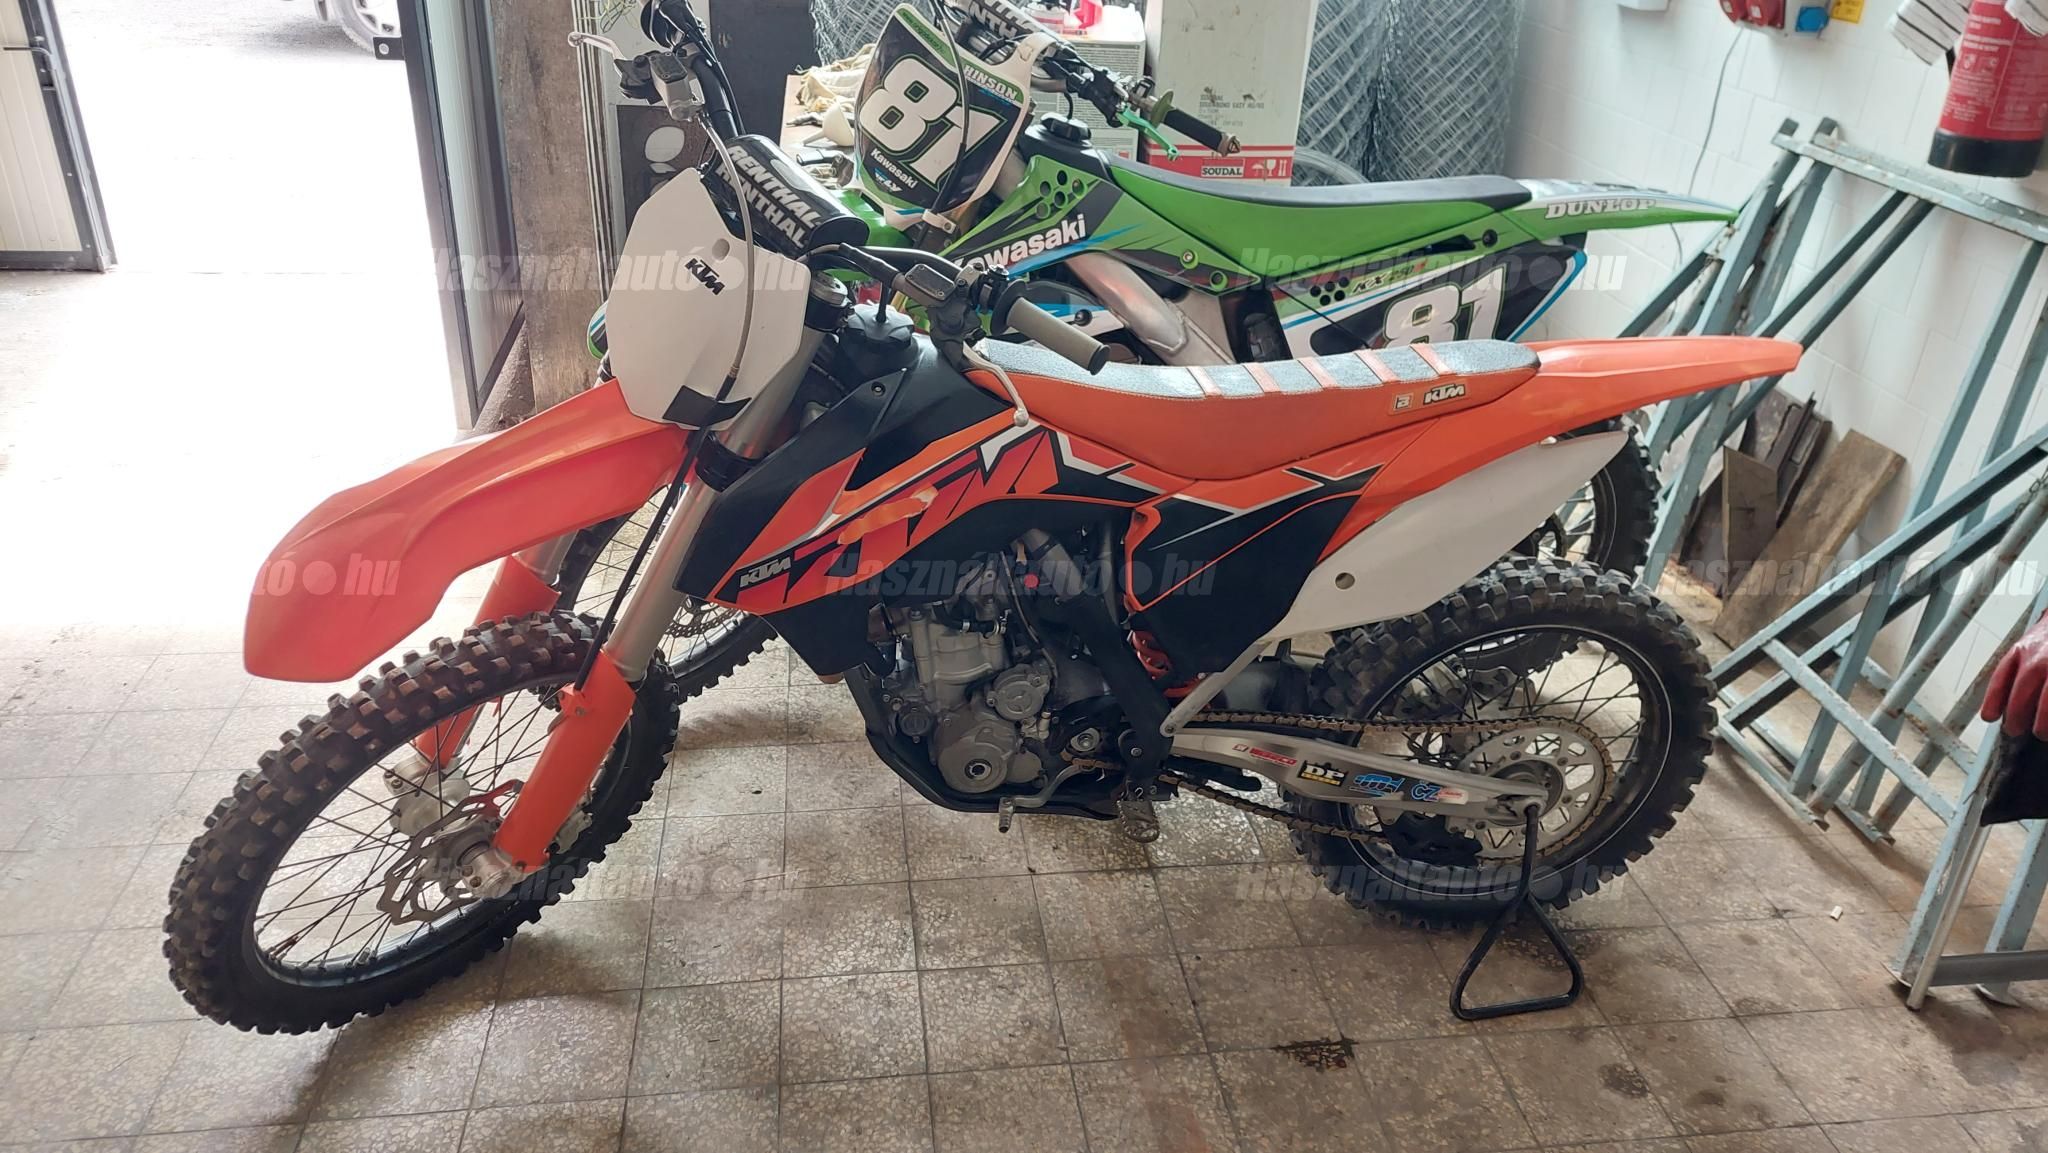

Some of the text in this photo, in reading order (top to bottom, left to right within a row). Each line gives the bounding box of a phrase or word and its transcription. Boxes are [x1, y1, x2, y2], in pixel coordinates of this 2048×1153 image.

[963, 64, 1018, 101] HINSON
[859, 57, 1001, 185] 81
[870, 148, 919, 188] Kawasaki
[1202, 167, 1243, 176] SOUDAL
[726, 145, 822, 229] RENTHAL
[1545, 199, 1656, 219] DUNLOP
[953, 213, 1087, 269] awasaki
[685, 258, 725, 296] KTM
[1385, 264, 1504, 349] 81
[1423, 384, 1466, 405] KTM
[740, 556, 792, 588] KTM
[1304, 764, 1346, 780] DP
